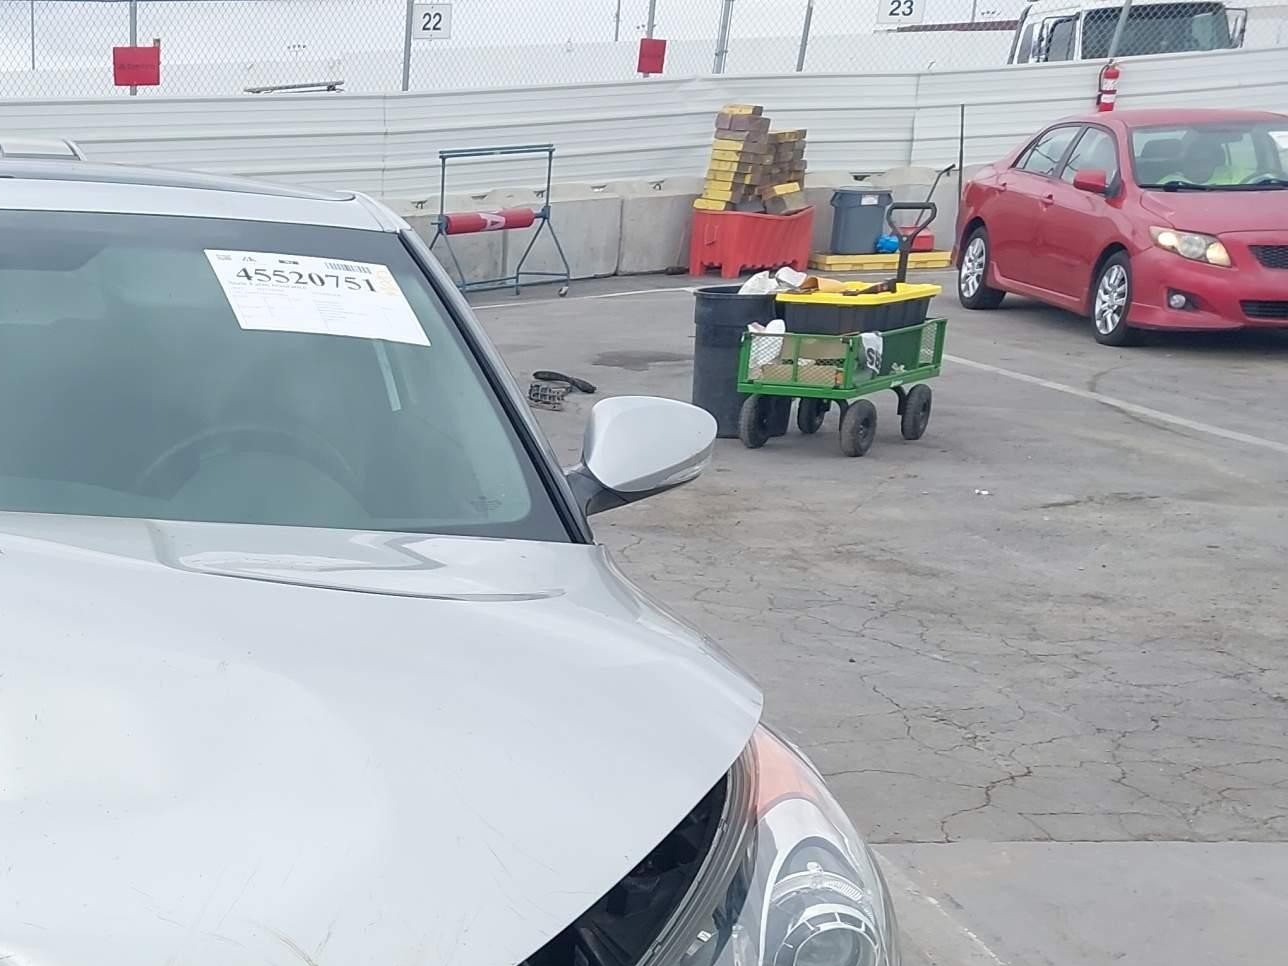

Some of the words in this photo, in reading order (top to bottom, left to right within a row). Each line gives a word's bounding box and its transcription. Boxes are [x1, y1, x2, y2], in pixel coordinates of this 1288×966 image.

[888, 0, 914, 16] 23
[422, 13, 442, 31] 22
[236, 267, 377, 292] 45520751
